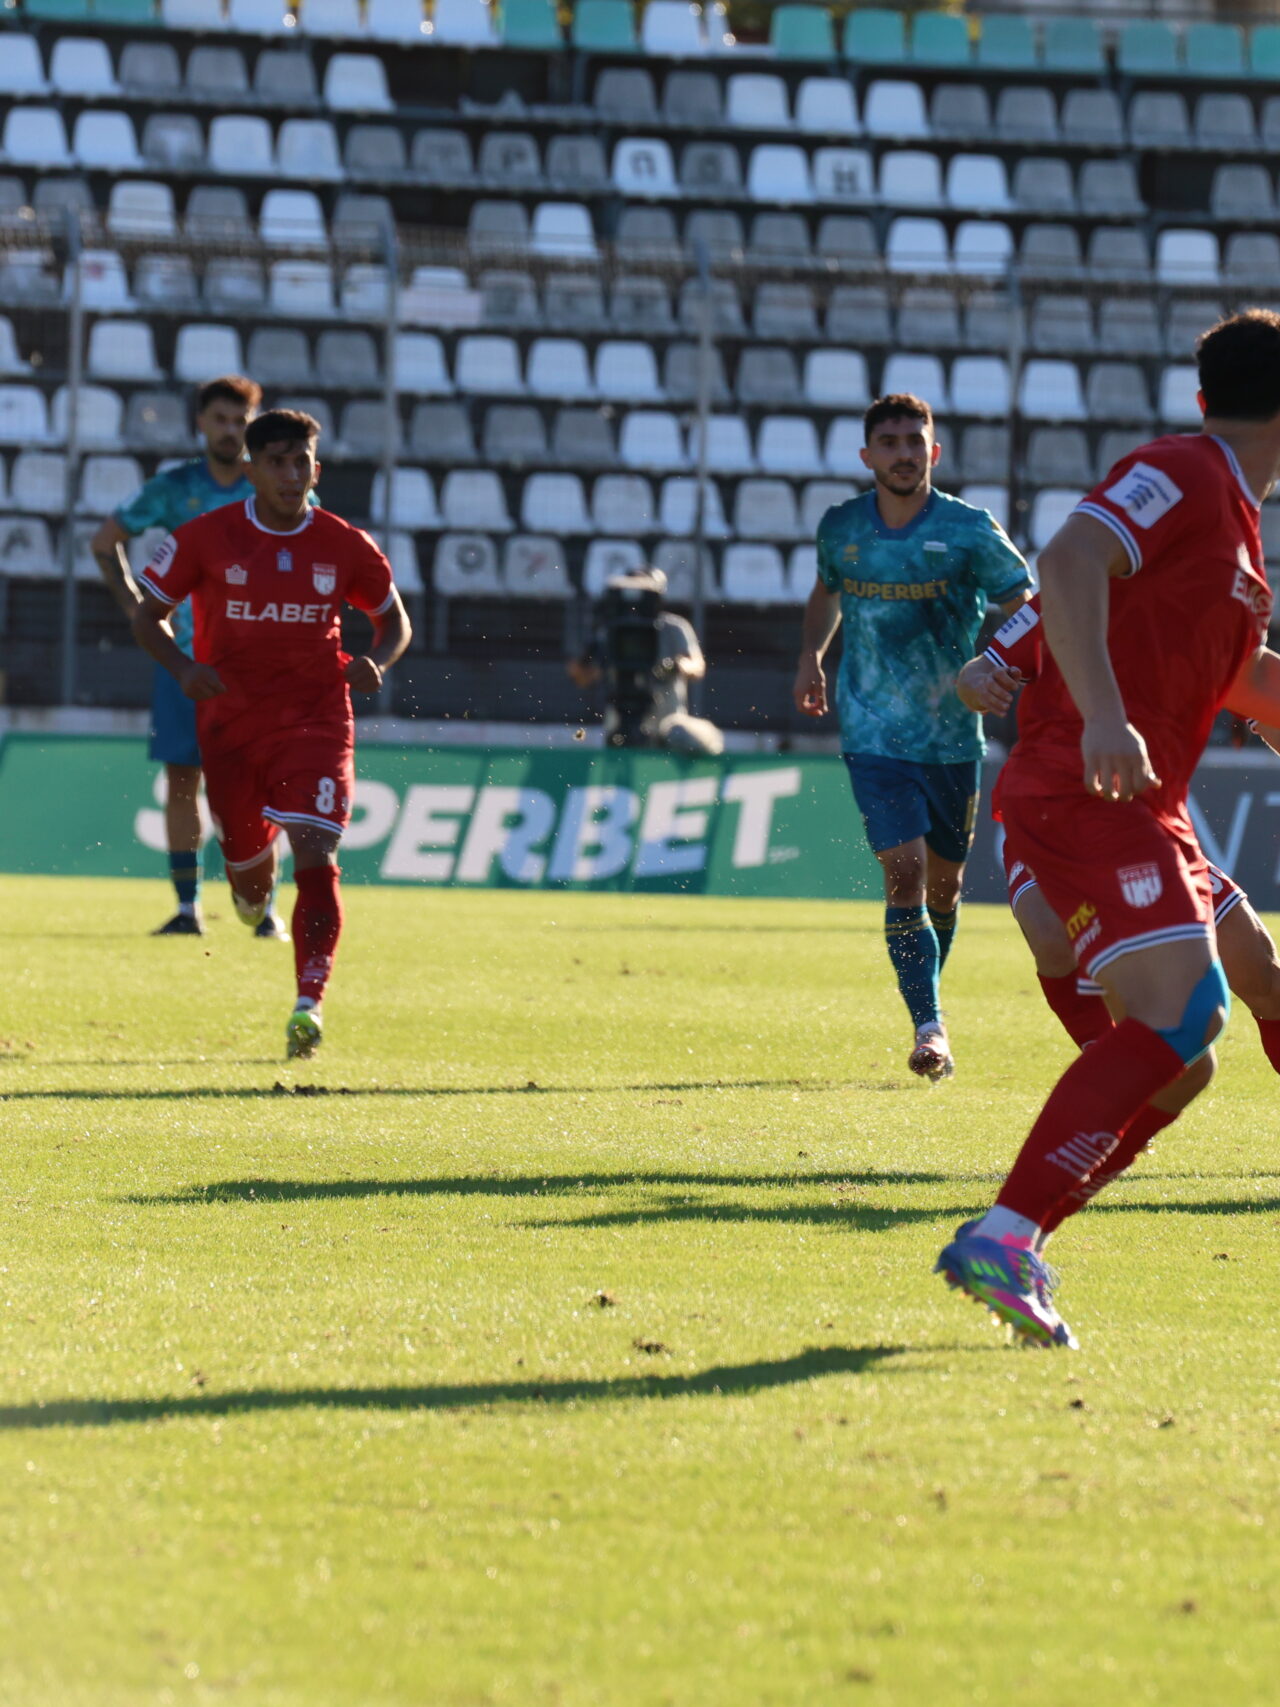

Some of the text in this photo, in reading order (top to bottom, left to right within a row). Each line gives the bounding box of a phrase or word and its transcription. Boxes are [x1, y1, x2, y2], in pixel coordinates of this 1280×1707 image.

[843, 578, 949, 600] SUPERBET
[225, 600, 332, 623] ELABET
[315, 776, 336, 815] 8
[134, 766, 801, 882] SPERBET
